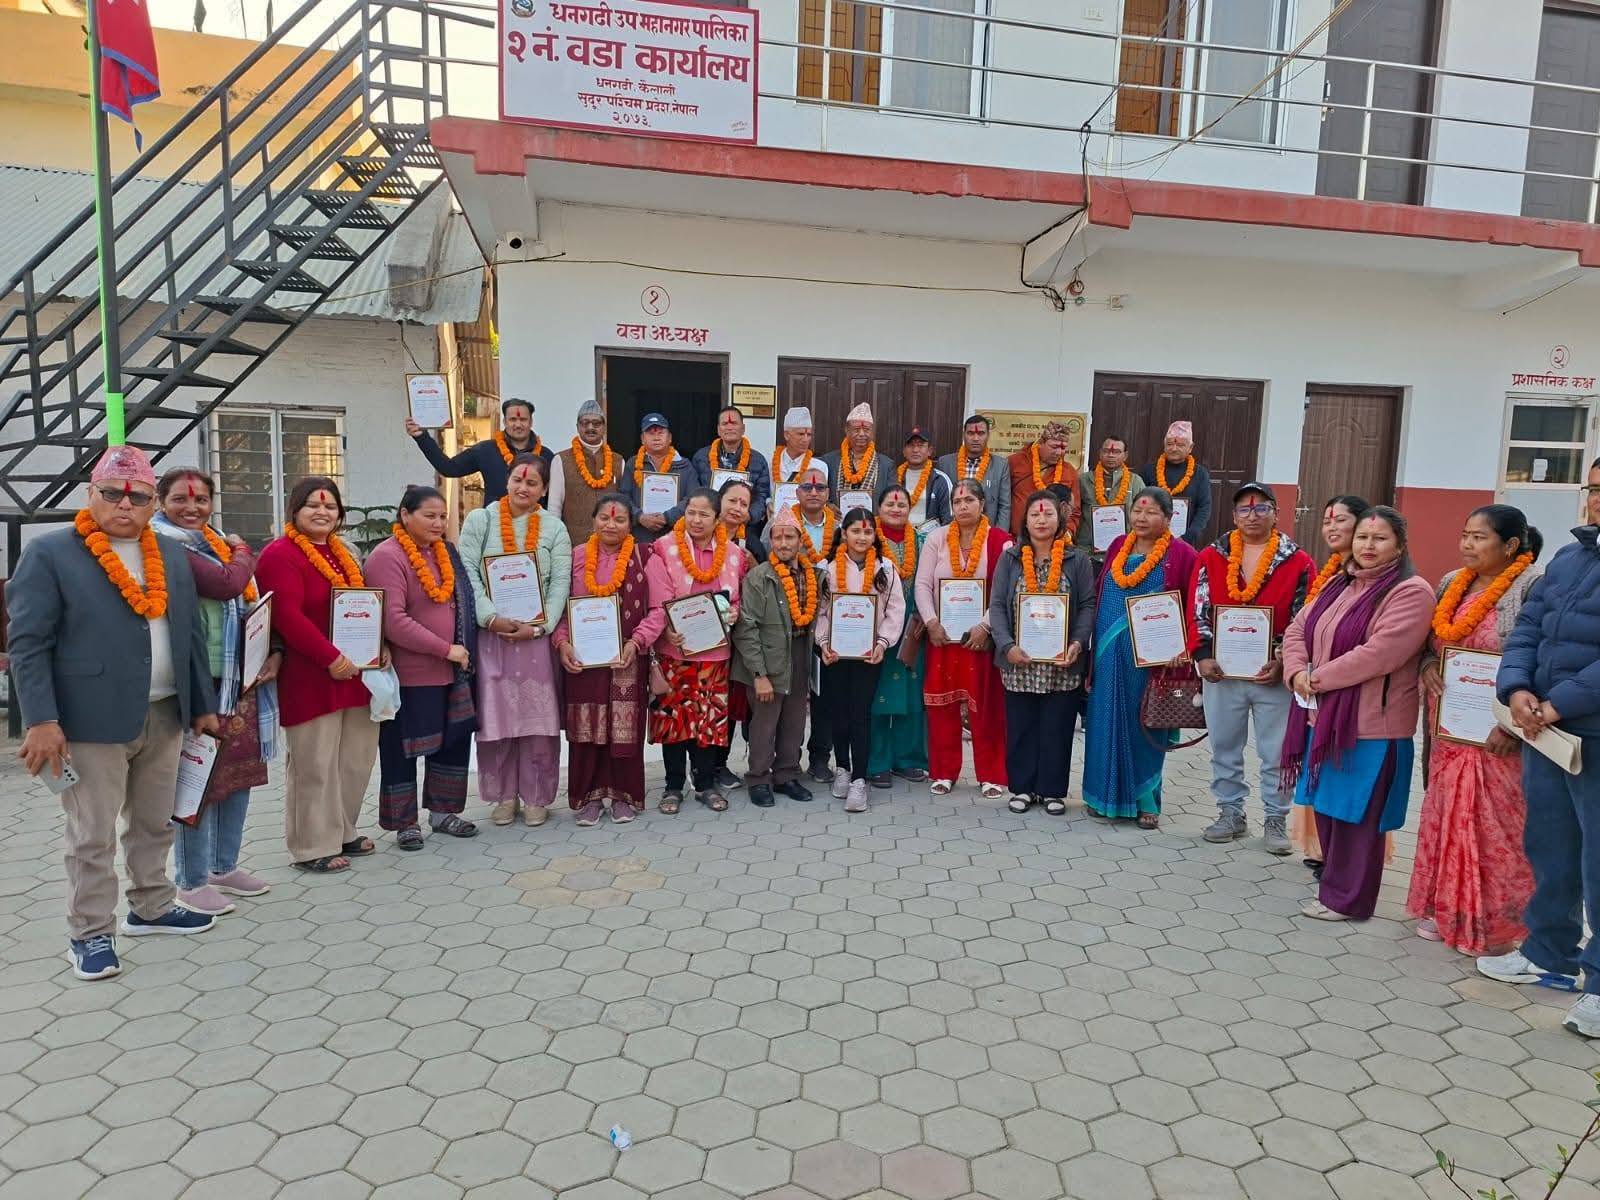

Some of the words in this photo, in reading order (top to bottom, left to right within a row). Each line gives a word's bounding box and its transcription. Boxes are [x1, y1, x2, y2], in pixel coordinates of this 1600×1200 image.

[549, 2, 612, 26] धनगढी
[615, 9, 638, 30] उप
[692, 14, 749, 42] पालिका
[508, 31, 526, 63] २
[566, 36, 626, 69] वडा
[635, 44, 750, 82] कार्यालय
[671, 99, 699, 116] नेपाल
[612, 111, 651, 127] २०७३
[650, 290, 660, 313] १
[616, 323, 647, 340] वडा
[652, 325, 709, 346] अध्यक्ष
[1553, 348, 1565, 367] २
[1511, 370, 1569, 388] प्रशासनिक
[1571, 377, 1596, 389] कक्ष
